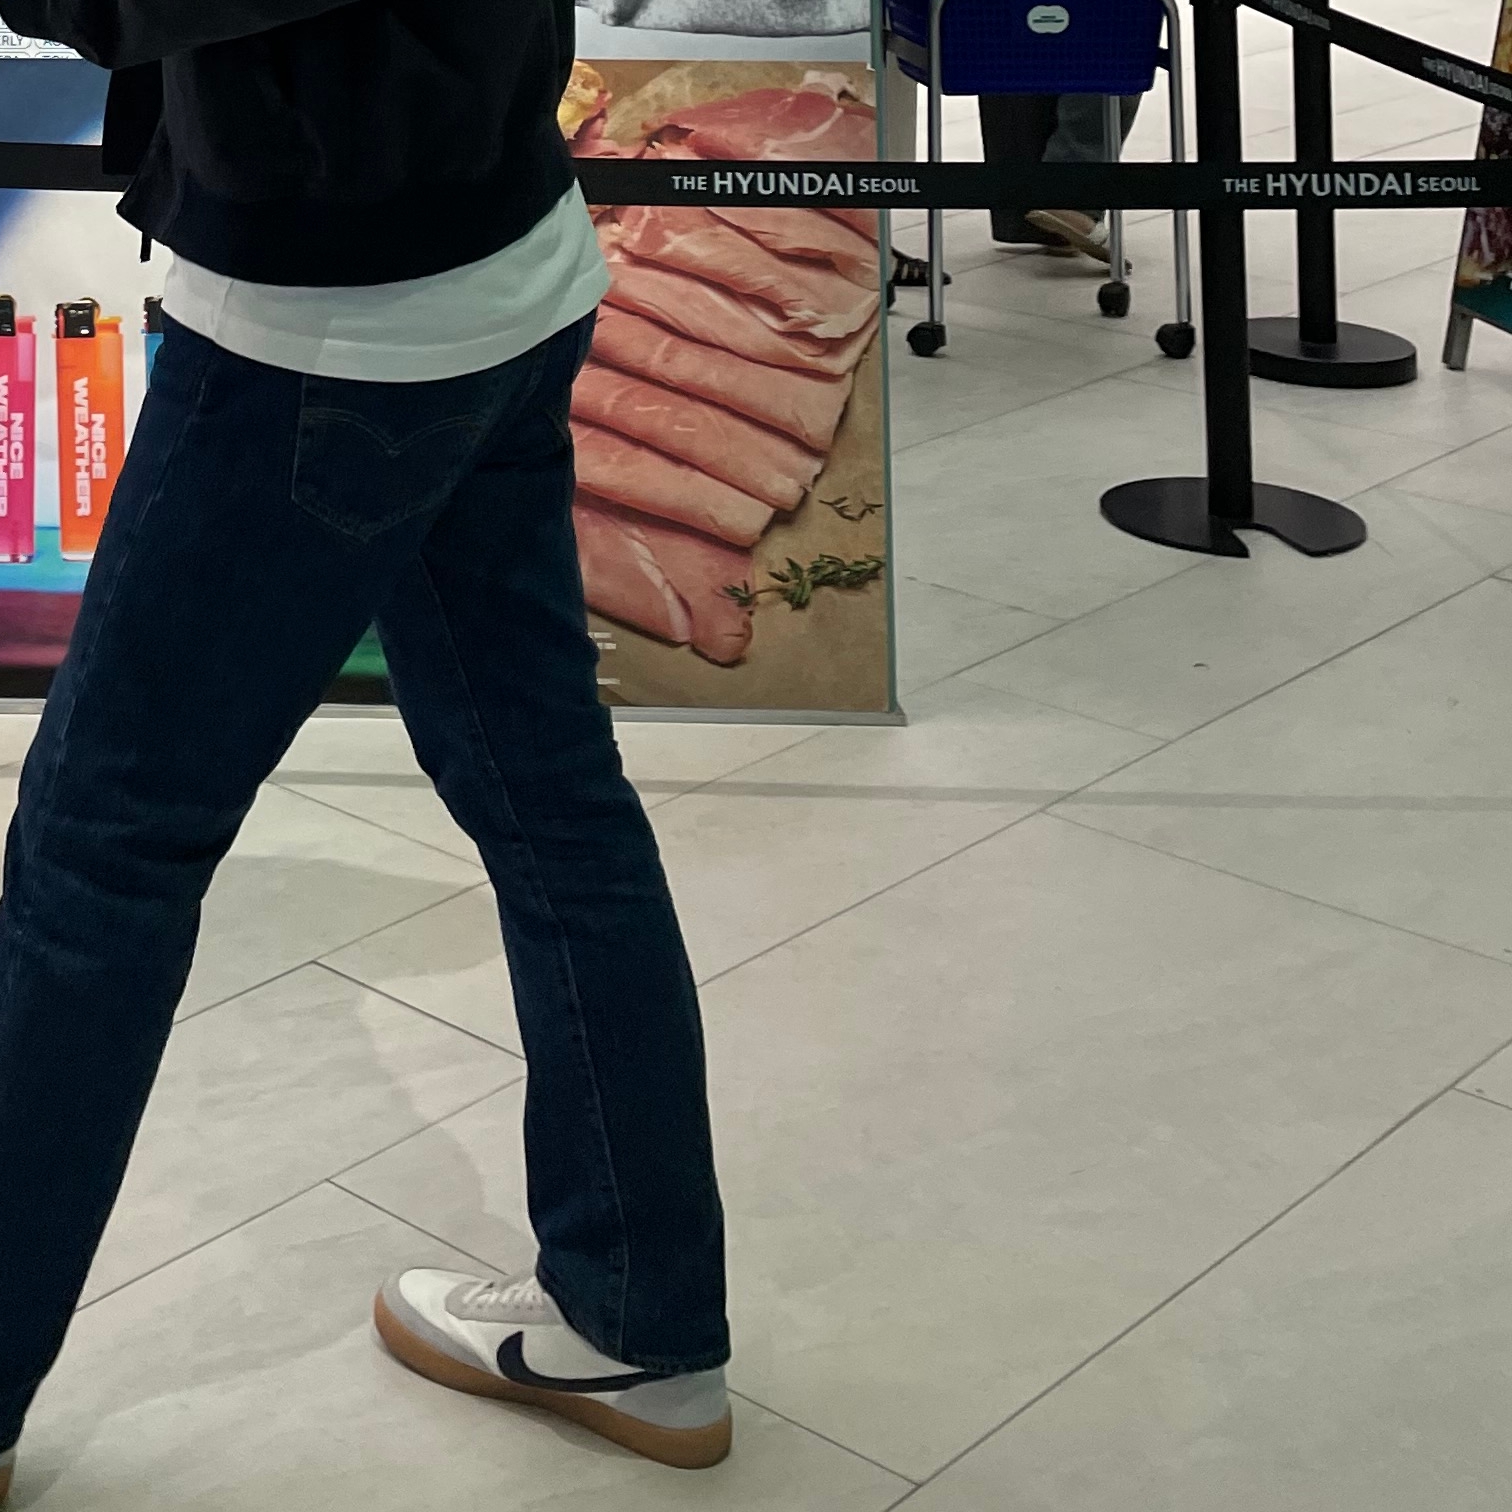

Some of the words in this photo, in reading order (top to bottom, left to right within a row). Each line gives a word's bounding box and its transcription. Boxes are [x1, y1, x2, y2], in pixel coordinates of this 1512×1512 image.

[672, 175, 707, 191] THE
[713, 171, 854, 196] HYUNDAI
[859, 178, 921, 193] SEOUL
[1222, 177, 1261, 193] THE
[1266, 172, 1413, 197] HYUNDAI
[1418, 176, 1481, 192] SEOUL
[10, 412, 24, 479] NICE
[73, 377, 90, 517] WEATHER
[90, 413, 106, 479] NICE
